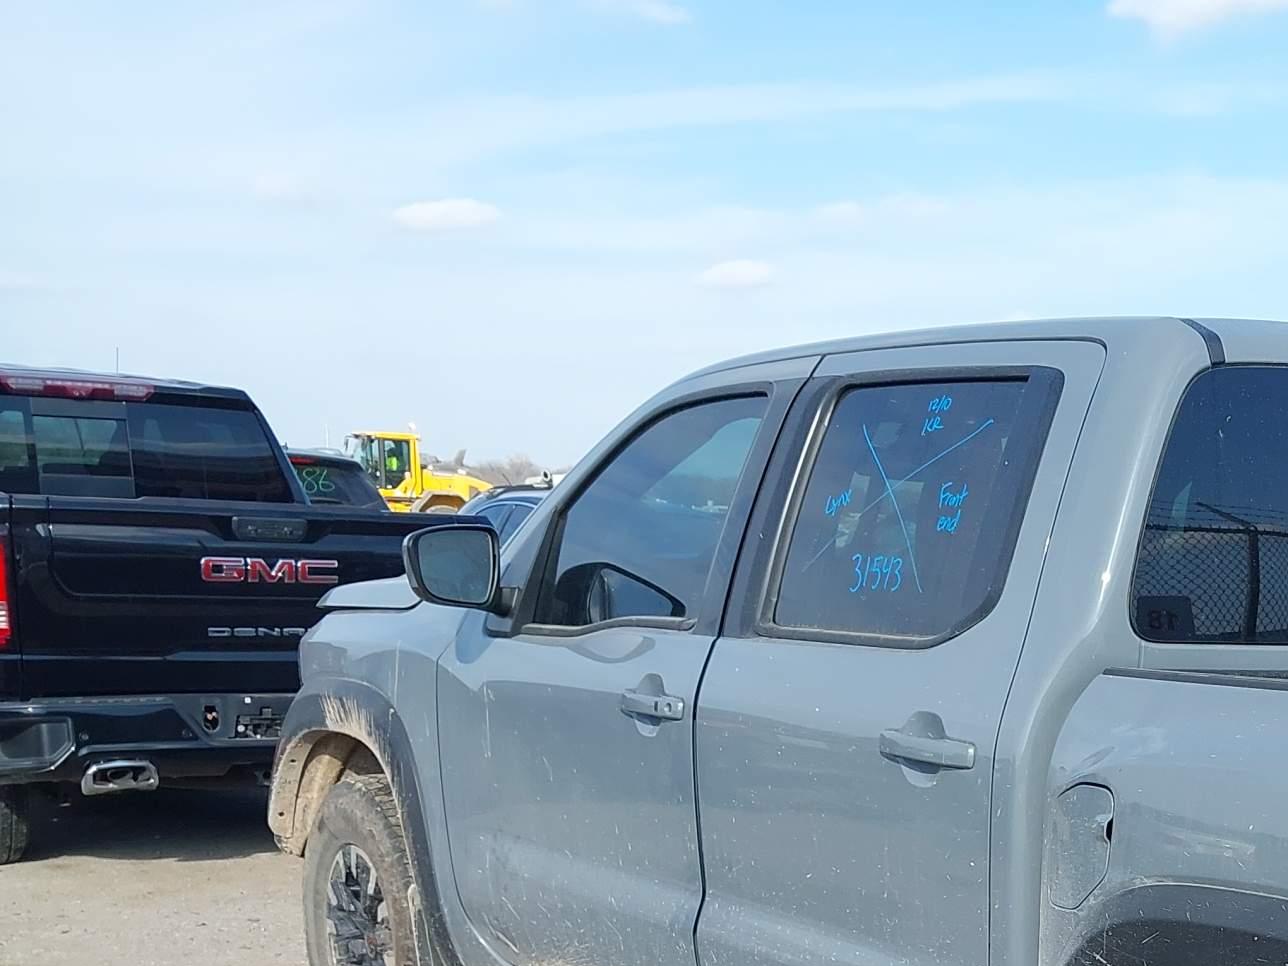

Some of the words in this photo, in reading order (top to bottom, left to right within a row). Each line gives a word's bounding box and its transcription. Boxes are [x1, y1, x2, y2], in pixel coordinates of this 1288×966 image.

[296, 467, 336, 494] 86
[938, 481, 969, 509] Front
[200, 556, 339, 583] GMC
[849, 553, 903, 593] 31543
[207, 627, 311, 637] DENA
